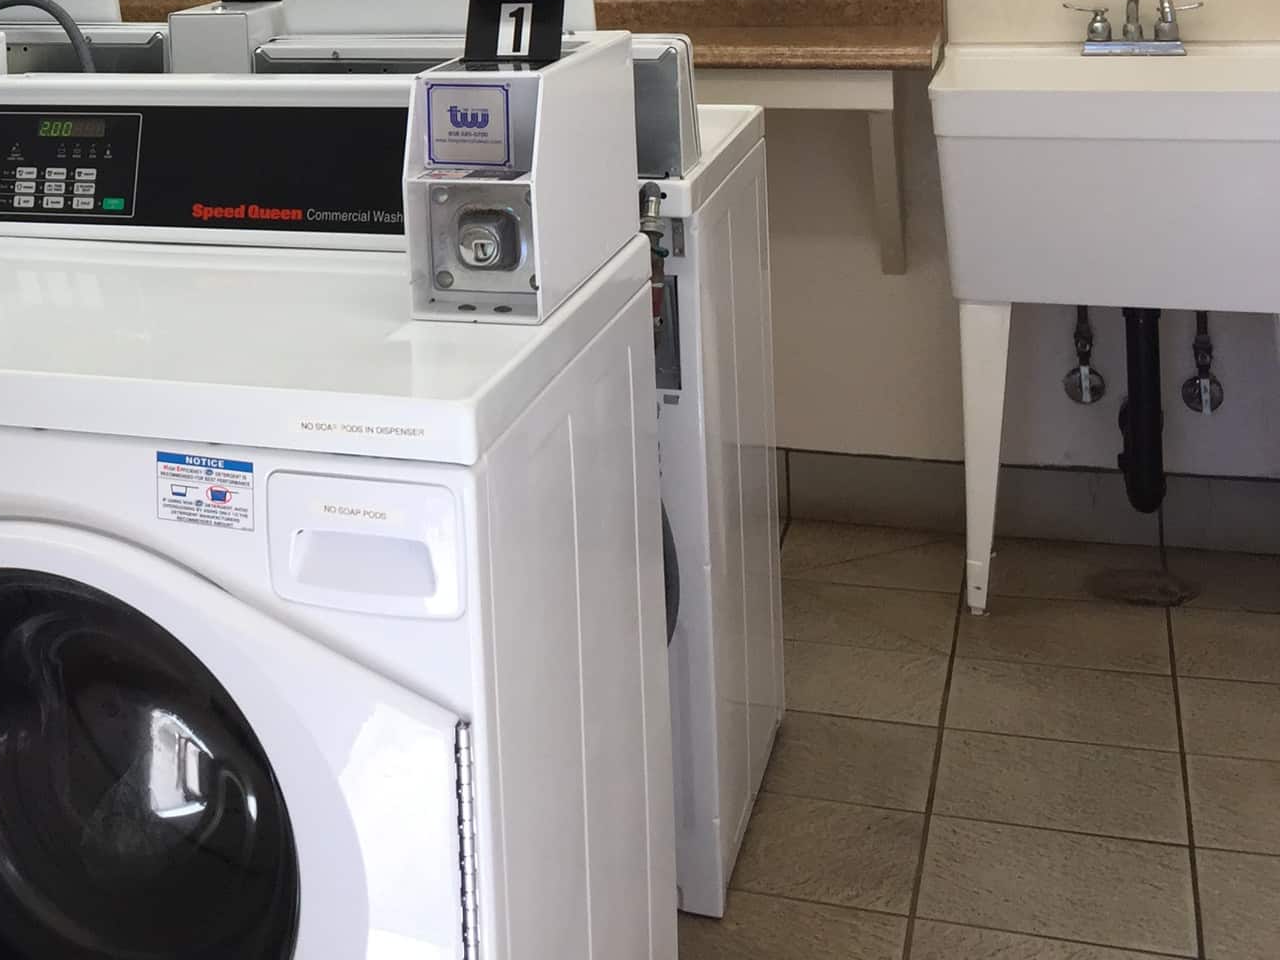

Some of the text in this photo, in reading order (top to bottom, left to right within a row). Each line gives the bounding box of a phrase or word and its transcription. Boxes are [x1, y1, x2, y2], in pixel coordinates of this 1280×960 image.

[510, 6, 526, 53] 1
[447, 106, 489, 128] tw
[192, 204, 245, 220] Speed
[248, 205, 303, 221] Queen
[307, 208, 369, 222] Commercial
[301, 422, 313, 430] NO
[376, 426, 424, 436] DISPENSER
[185, 456, 224, 468] NOTICE
